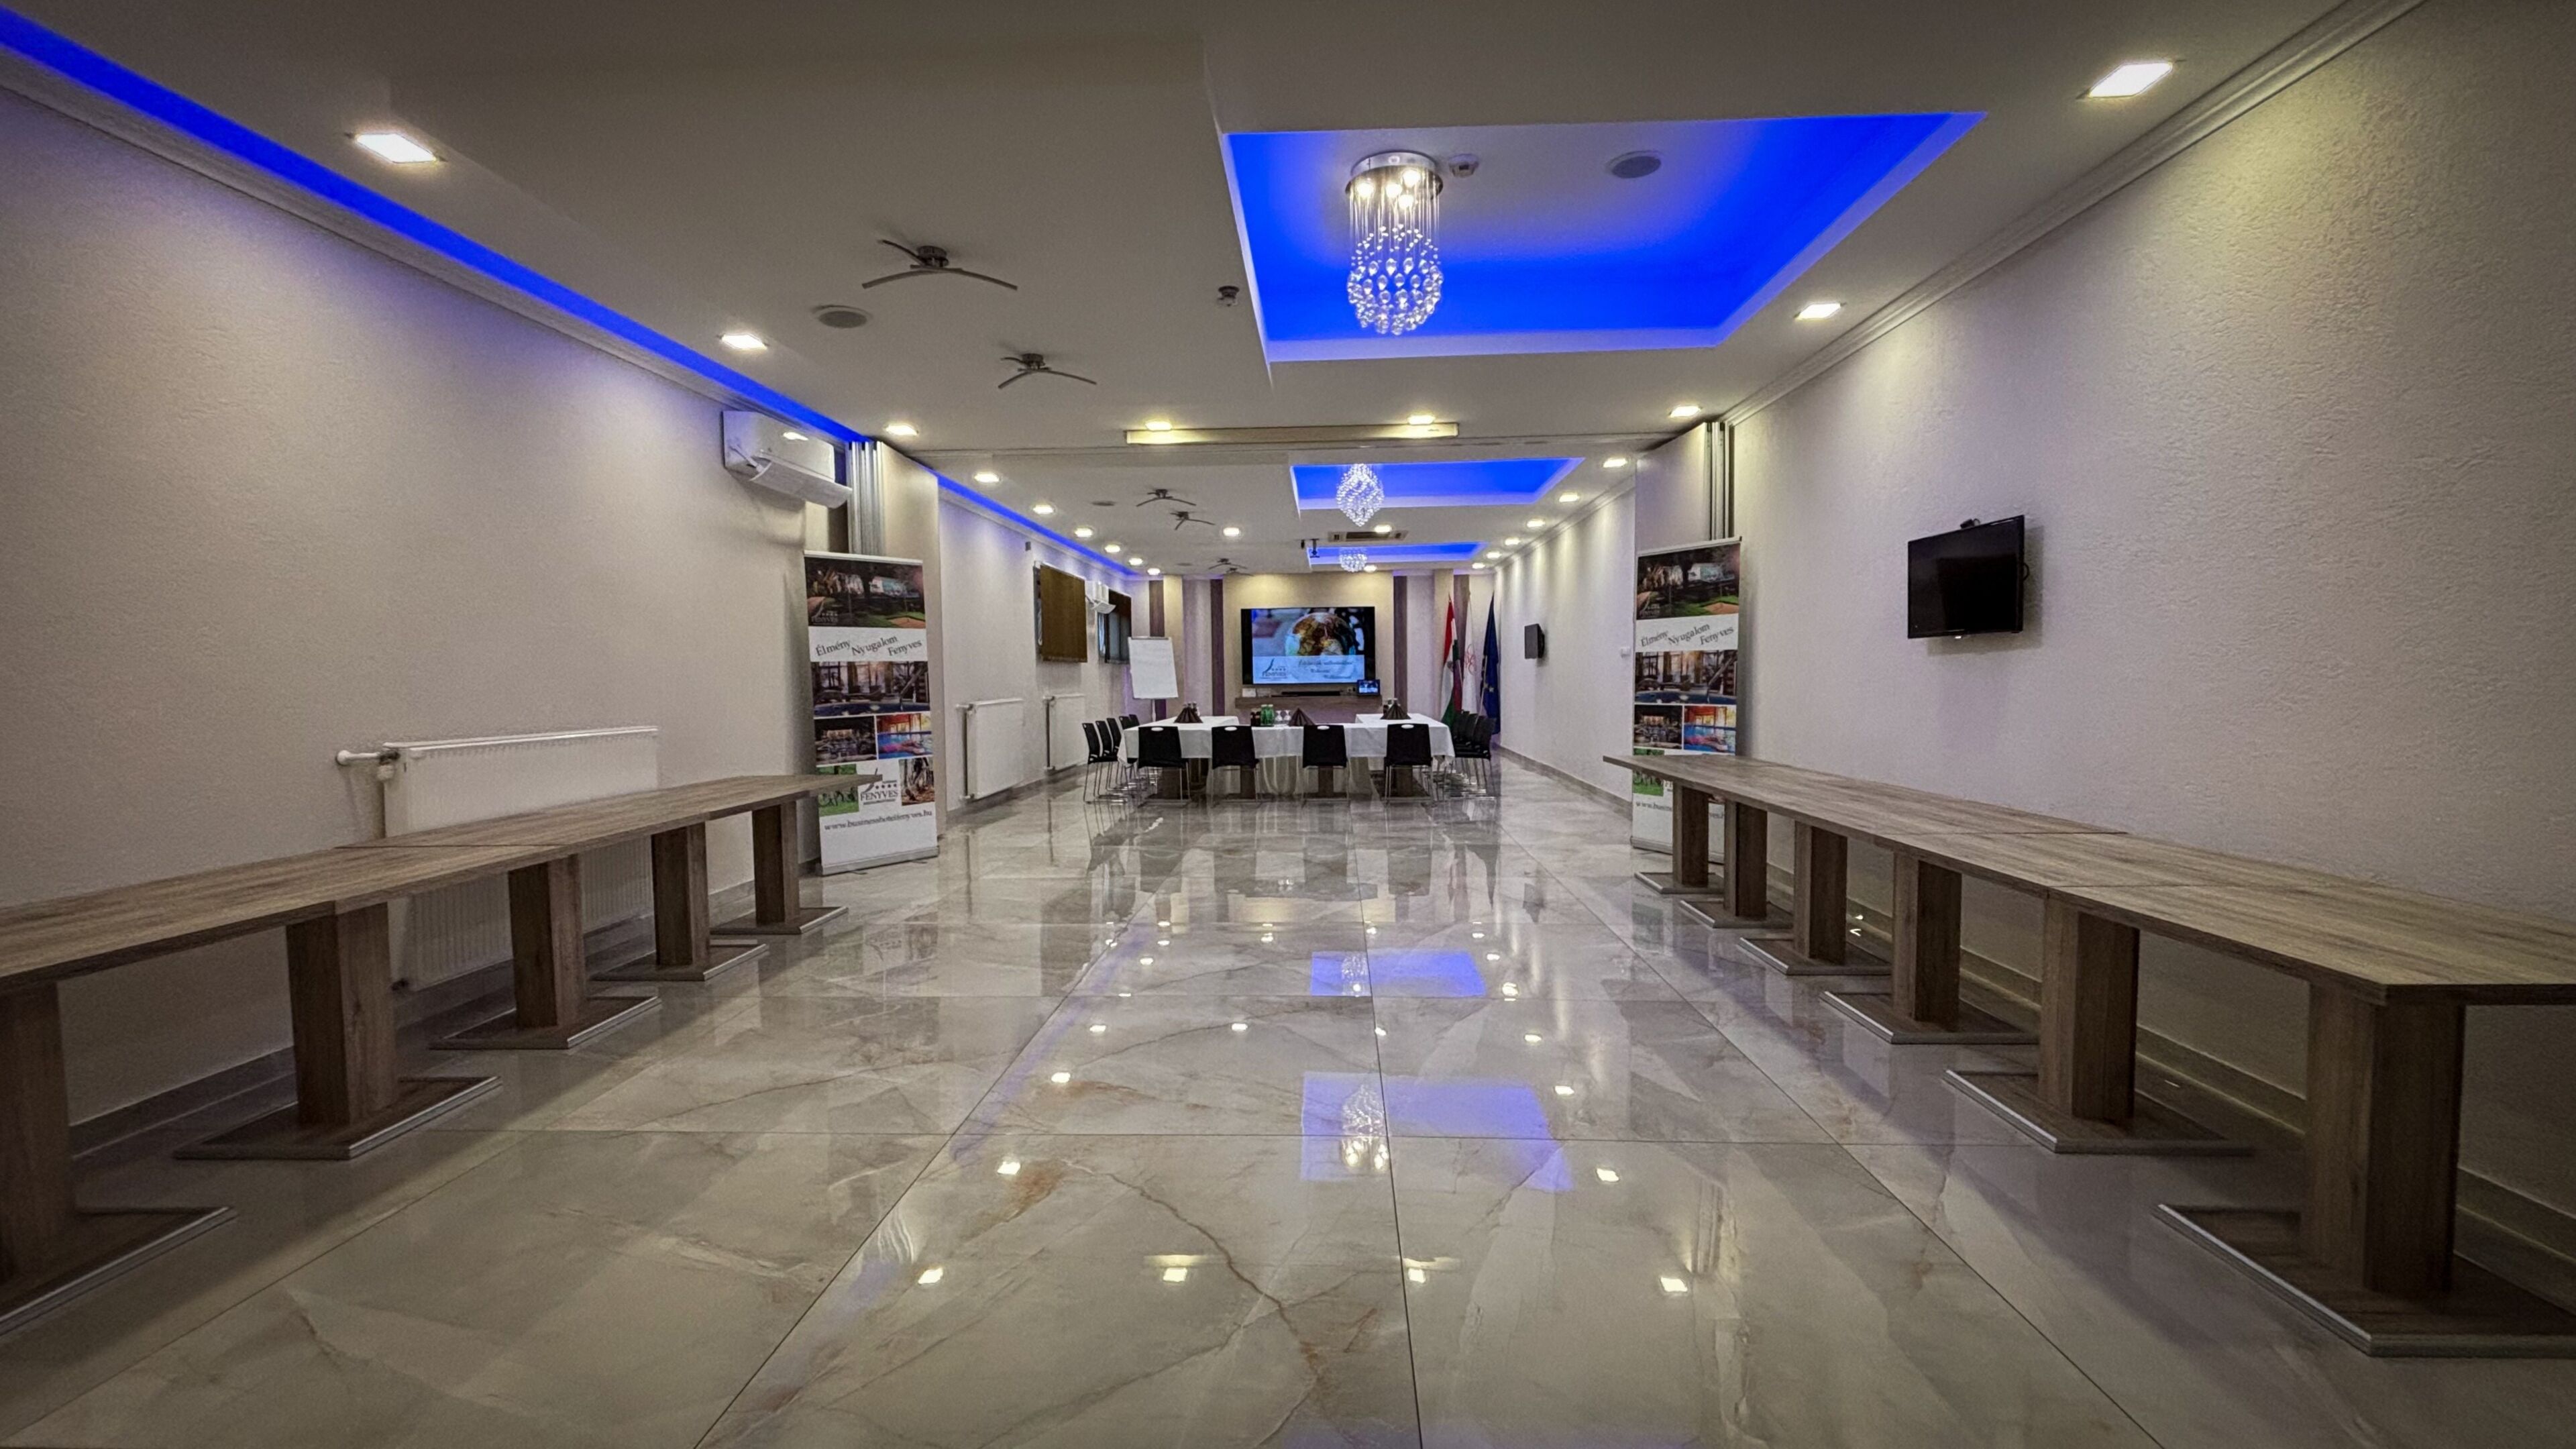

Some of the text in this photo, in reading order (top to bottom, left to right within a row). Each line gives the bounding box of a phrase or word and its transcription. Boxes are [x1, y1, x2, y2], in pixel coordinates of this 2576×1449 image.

[1668, 624, 1710, 645] Nyugalom
[1700, 627, 1734, 645] Fenyves
[815, 636, 922, 657] Élmény Nyugalom Fenyves
[860, 790, 898, 802] FENYVES
